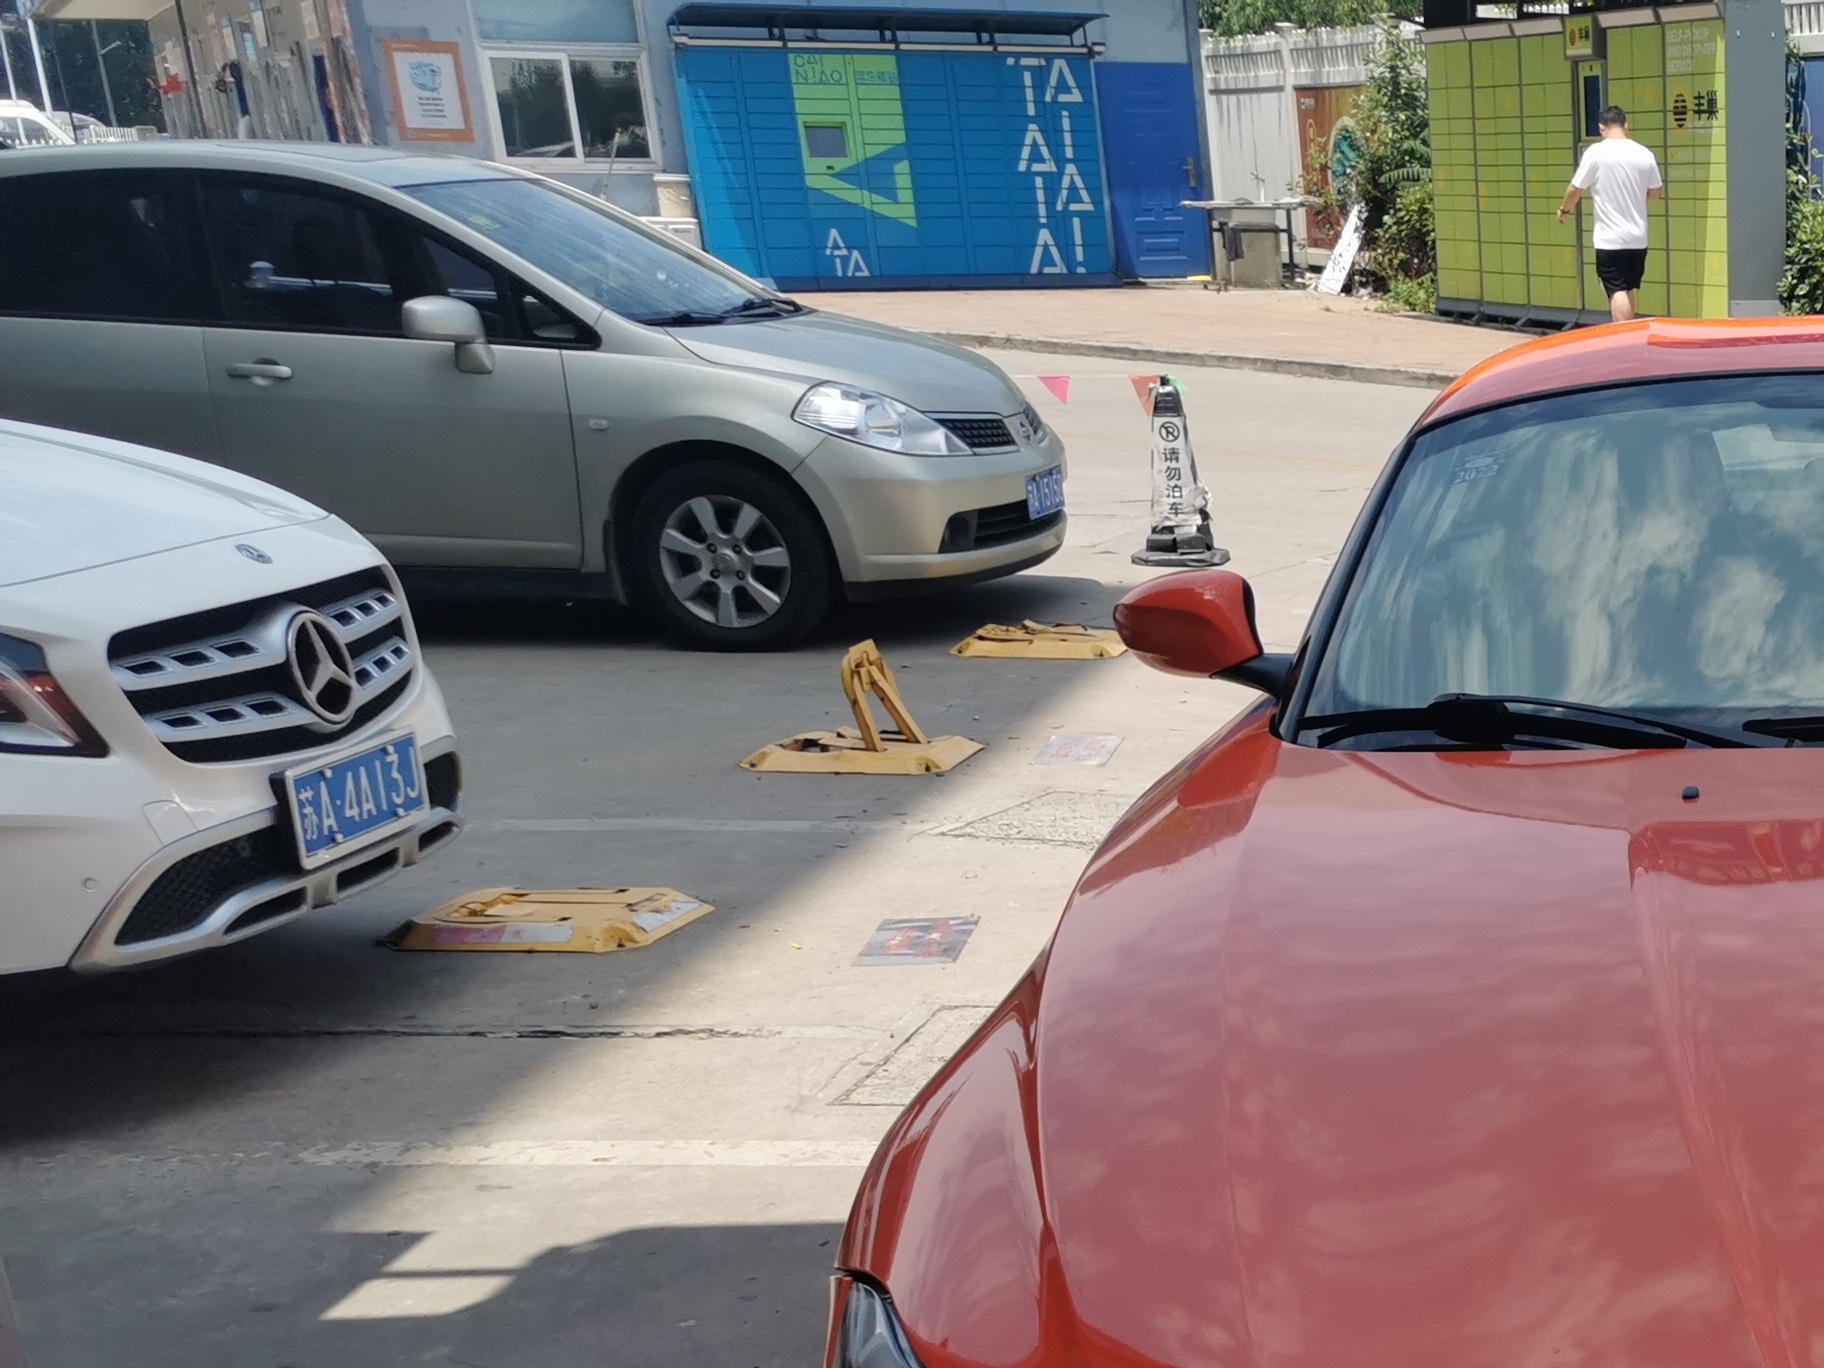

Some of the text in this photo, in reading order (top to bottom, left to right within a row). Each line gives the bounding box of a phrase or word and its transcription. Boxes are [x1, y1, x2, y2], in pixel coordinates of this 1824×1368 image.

[1693, 90, 1718, 121] 丰巢
[1162, 447, 1183, 517] 请勿泊车
